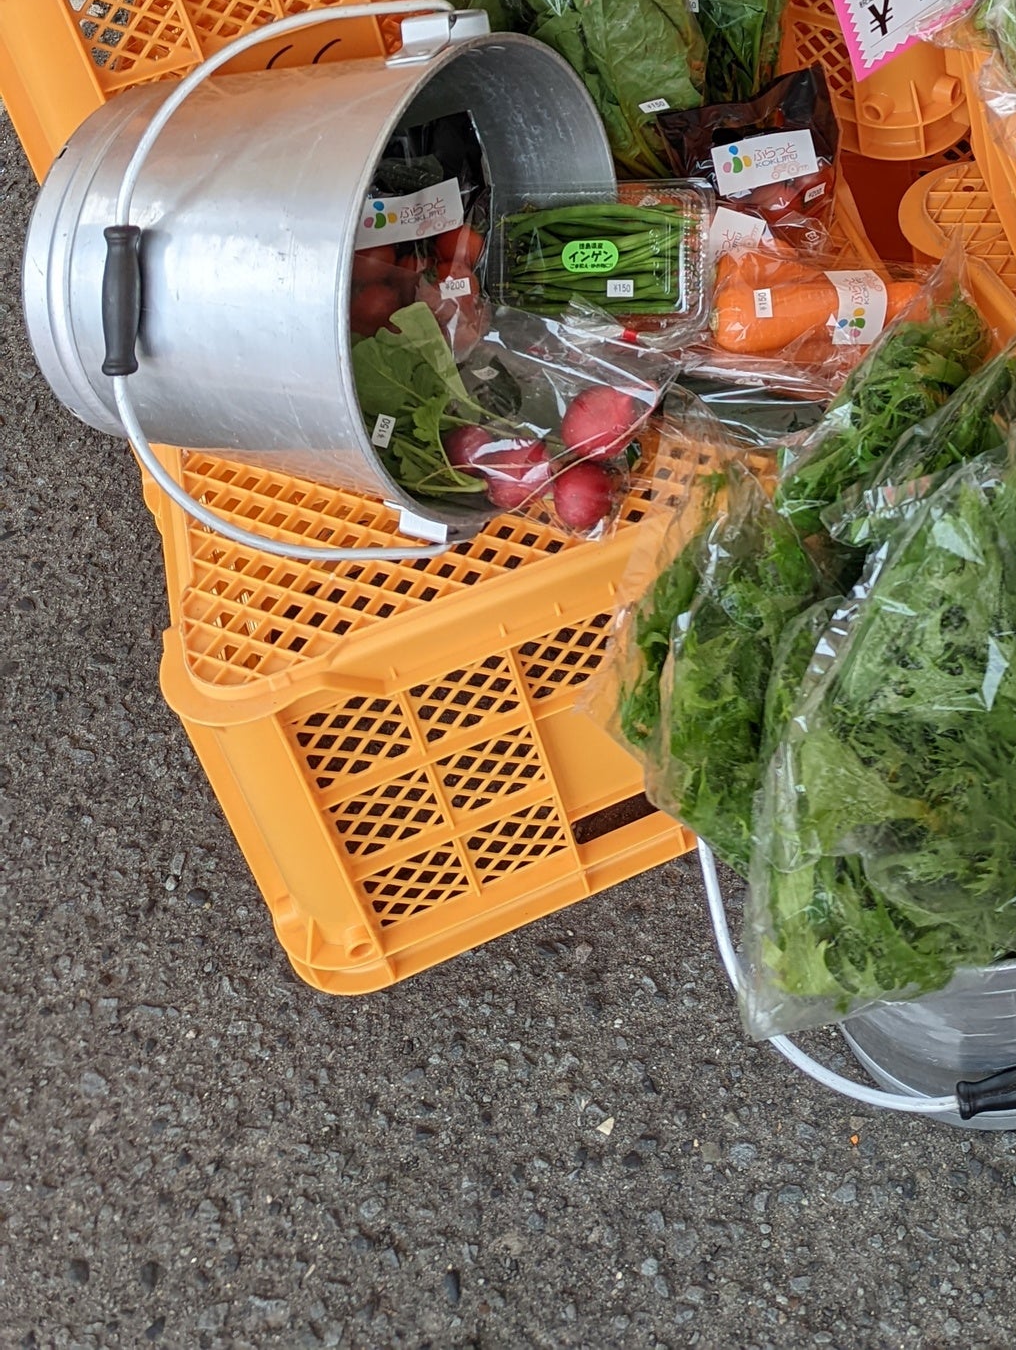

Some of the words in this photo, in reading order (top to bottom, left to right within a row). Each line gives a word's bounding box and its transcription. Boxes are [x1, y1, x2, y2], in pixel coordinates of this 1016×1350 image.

[648, 100, 665, 109] ¥150
[754, 143, 797, 161] ふらっと
[400, 197, 446, 218] ふらっと
[569, 251, 613, 262] インゲン
[445, 280, 465, 290] ¥200
[613, 284, 631, 293] ¥150
[758, 292, 767, 310] ¥150
[377, 418, 391, 439] ¥150
